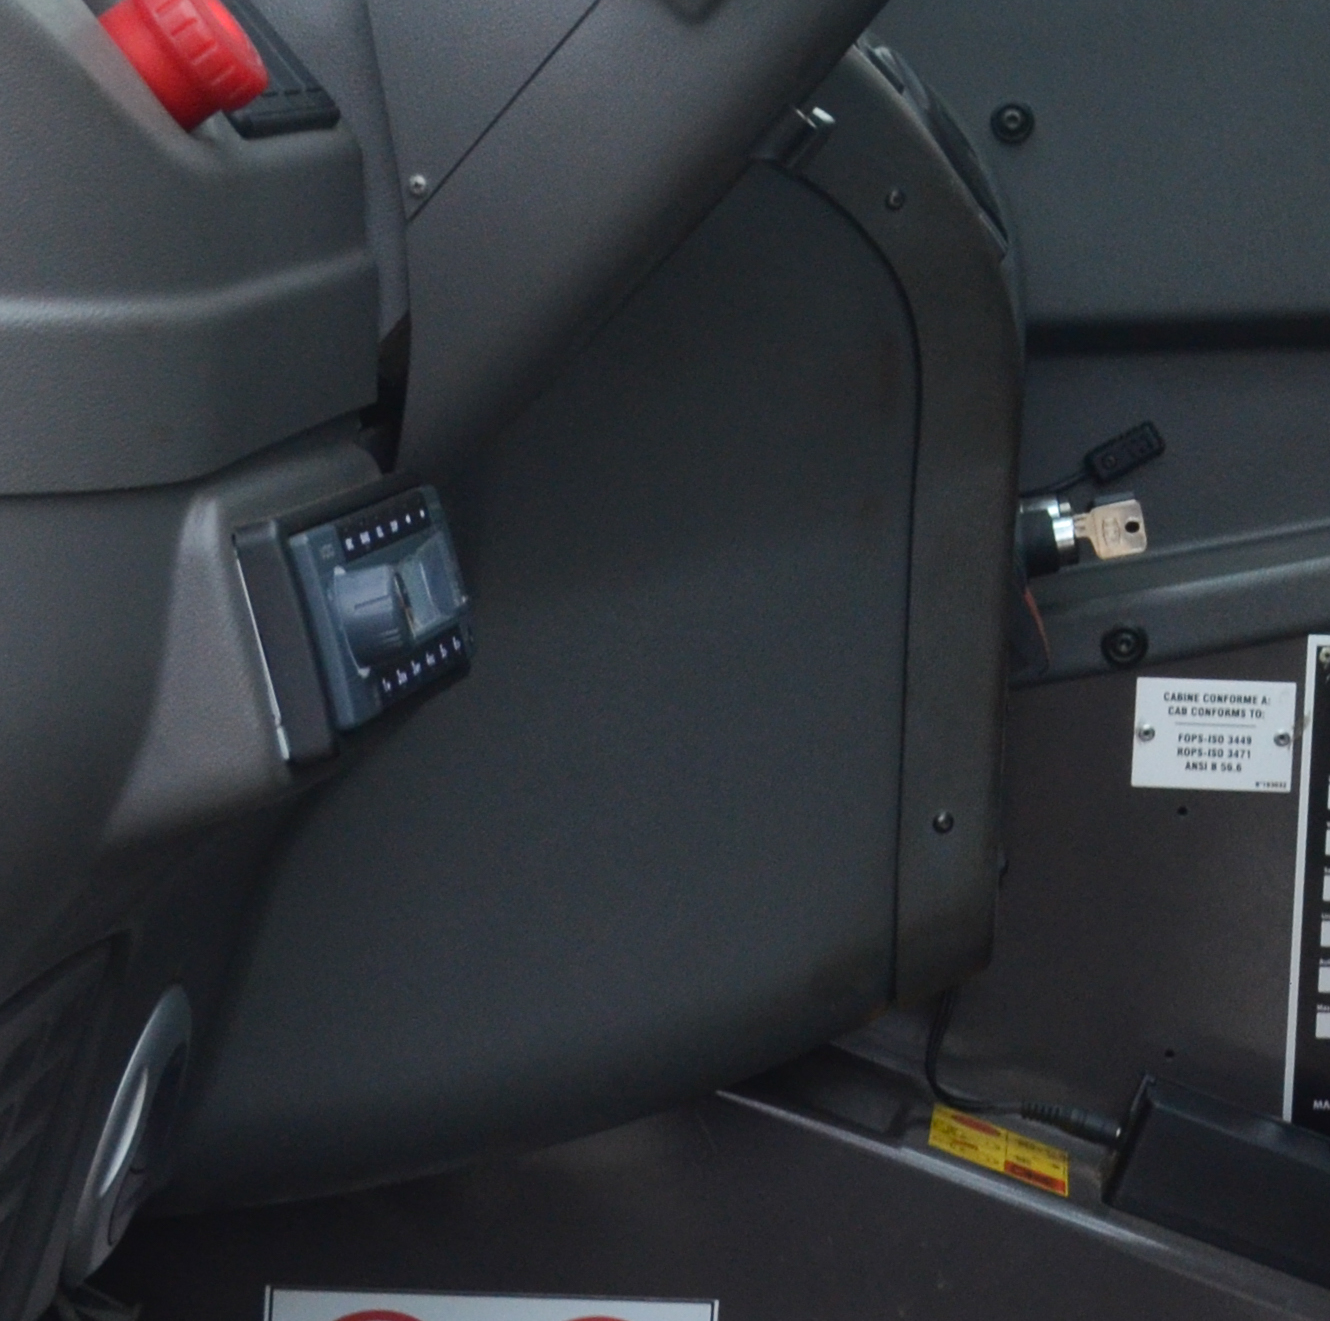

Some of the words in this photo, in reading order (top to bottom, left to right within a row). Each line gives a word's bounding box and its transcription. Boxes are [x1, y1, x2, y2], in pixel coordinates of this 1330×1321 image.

[1163, 692, 1199, 702] CABINE
[1203, 693, 1257, 705] CONFORME
[1261, 696, 1271, 705] A:
[1168, 706, 1188, 716] CAB
[1191, 707, 1246, 718] CONFORMS
[1250, 709, 1265, 719] TO:
[1178, 733, 1224, 744] FOPS-ISO
[1228, 734, 1252, 745] 3449
[1177, 747, 1224, 758] ROPS-ISO
[1227, 748, 1251, 759] 3471
[1185, 762, 1207, 771] ANSI
